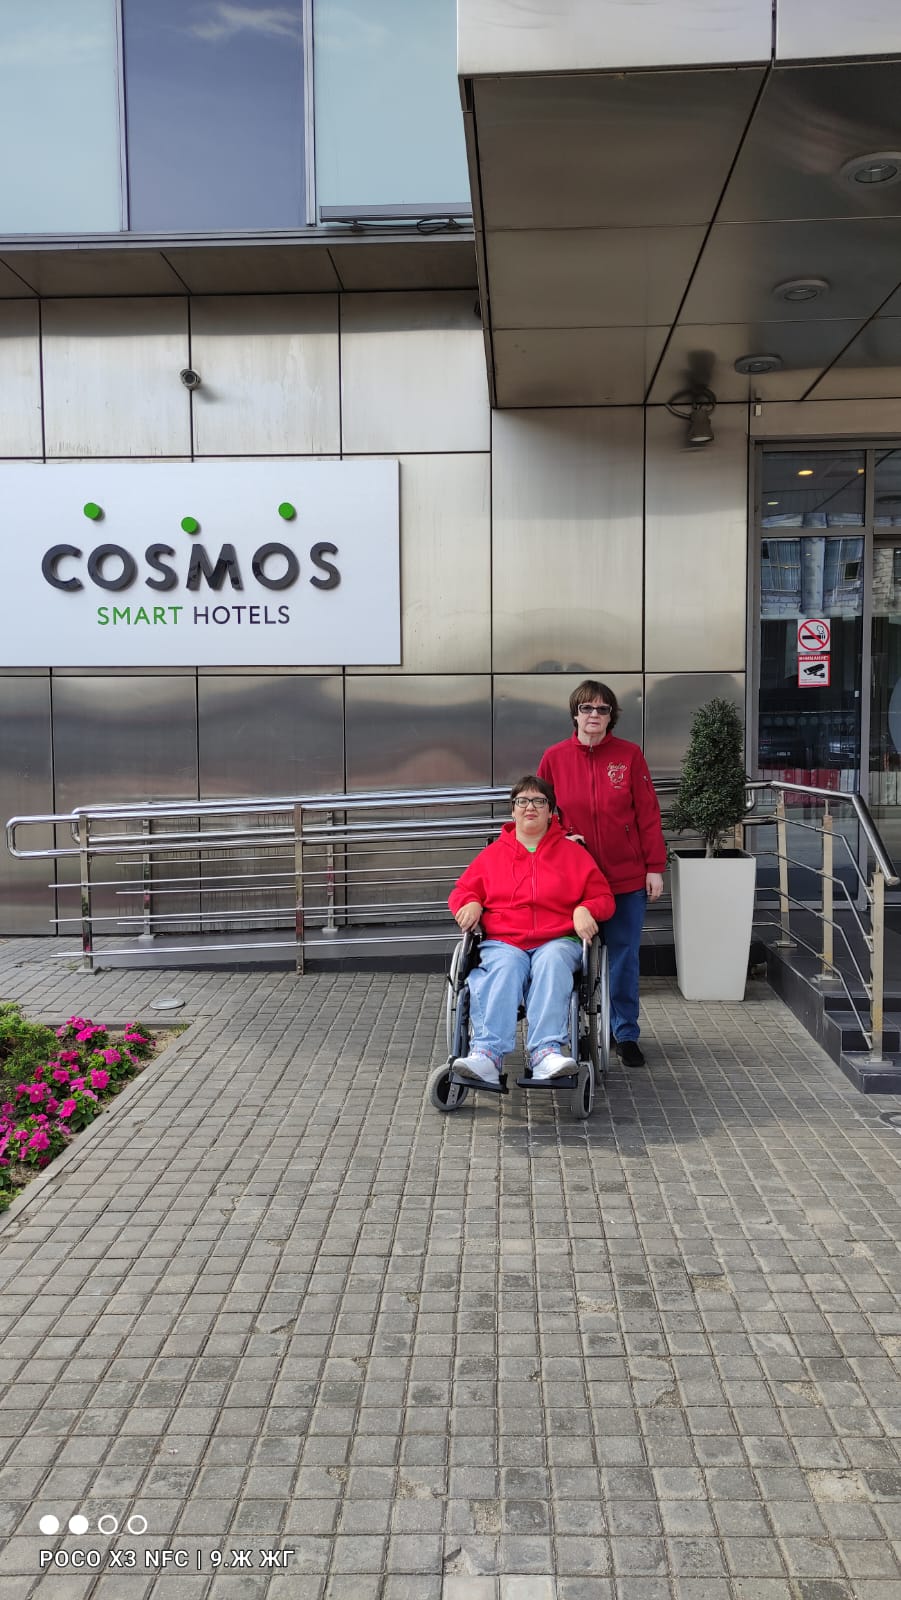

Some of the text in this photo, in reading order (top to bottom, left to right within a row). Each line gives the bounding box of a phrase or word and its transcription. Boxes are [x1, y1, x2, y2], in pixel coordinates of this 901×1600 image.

[41, 541, 341, 593] COSMOS
[97, 605, 290, 625] SMART HOTELS
